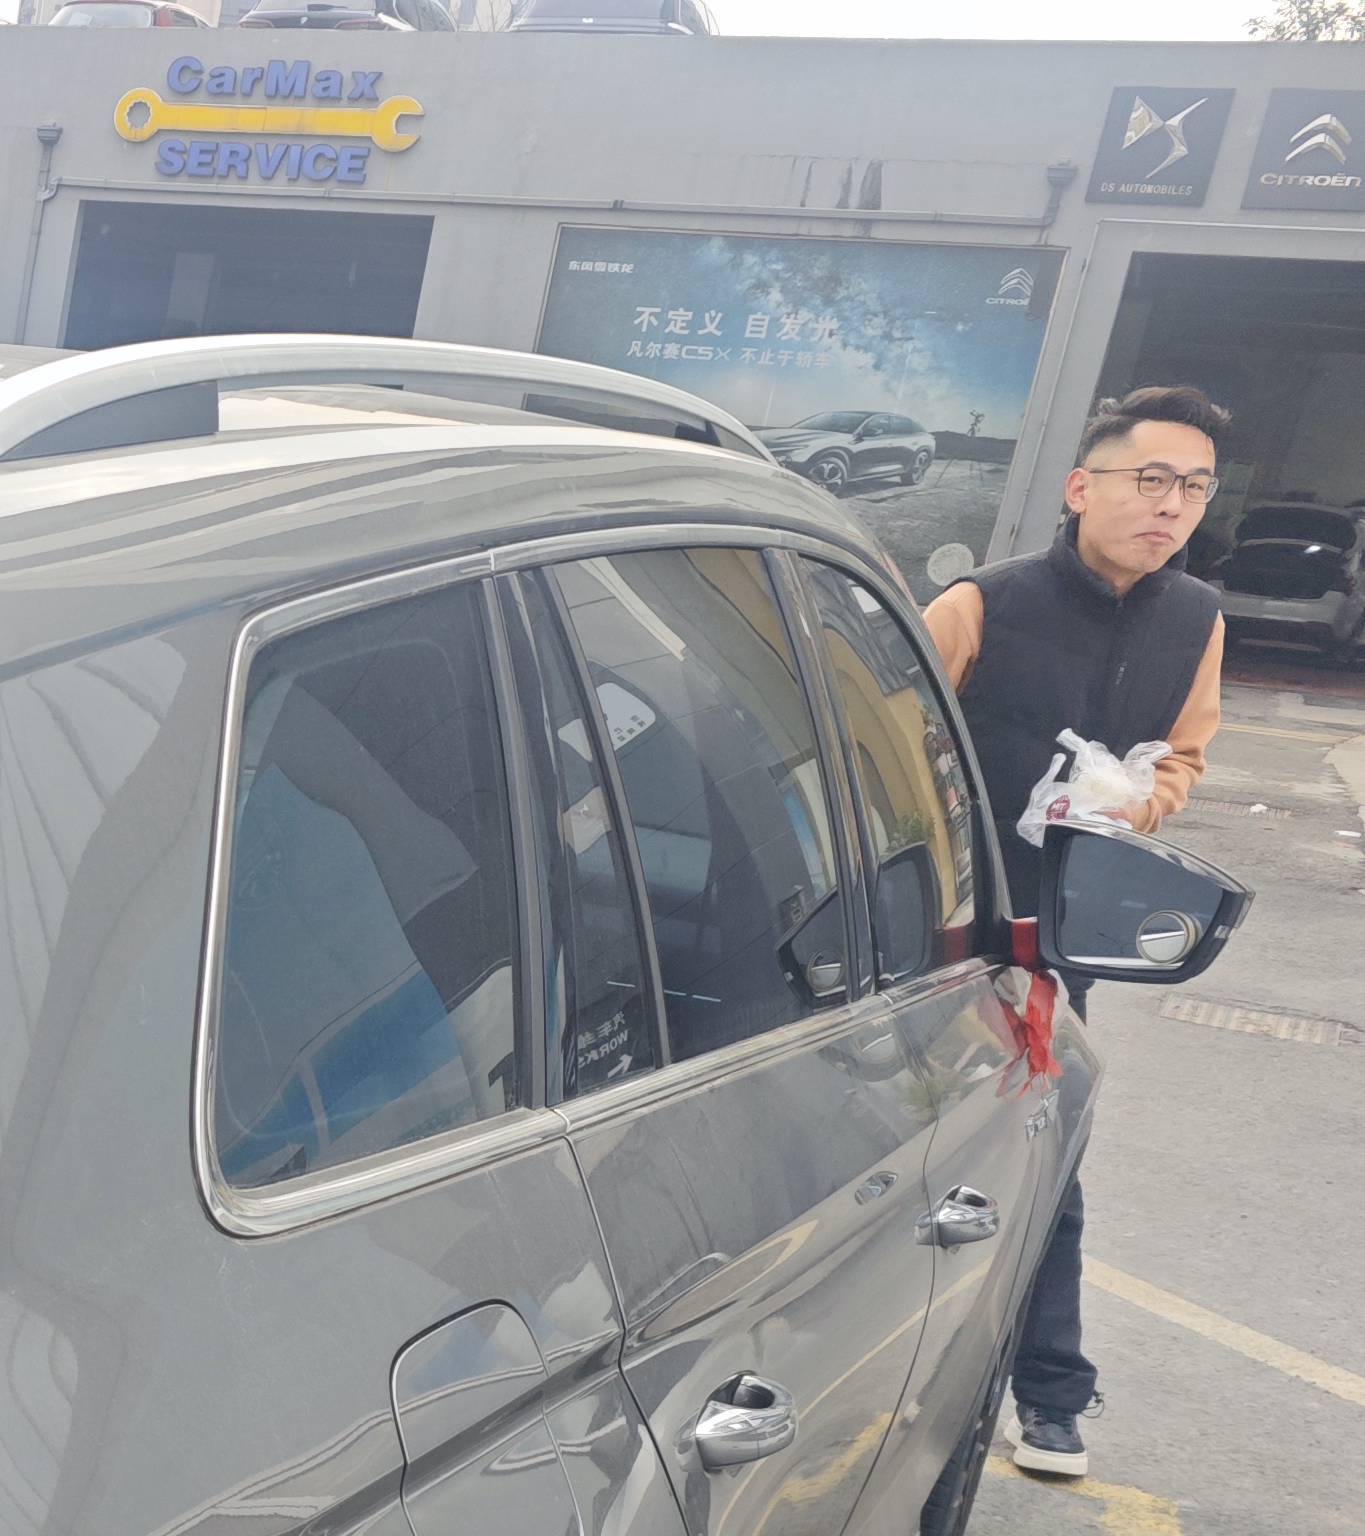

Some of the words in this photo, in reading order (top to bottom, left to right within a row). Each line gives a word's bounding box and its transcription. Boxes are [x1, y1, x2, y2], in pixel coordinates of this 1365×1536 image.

[167, 56, 382, 100] CarMax
[155, 139, 370, 183] SERVICE
[1101, 182, 1116, 193] DS
[1119, 183, 1193, 196] AUTOMOBILES
[633, 306, 724, 336] 不定义
[744, 311, 842, 341] 自发光
